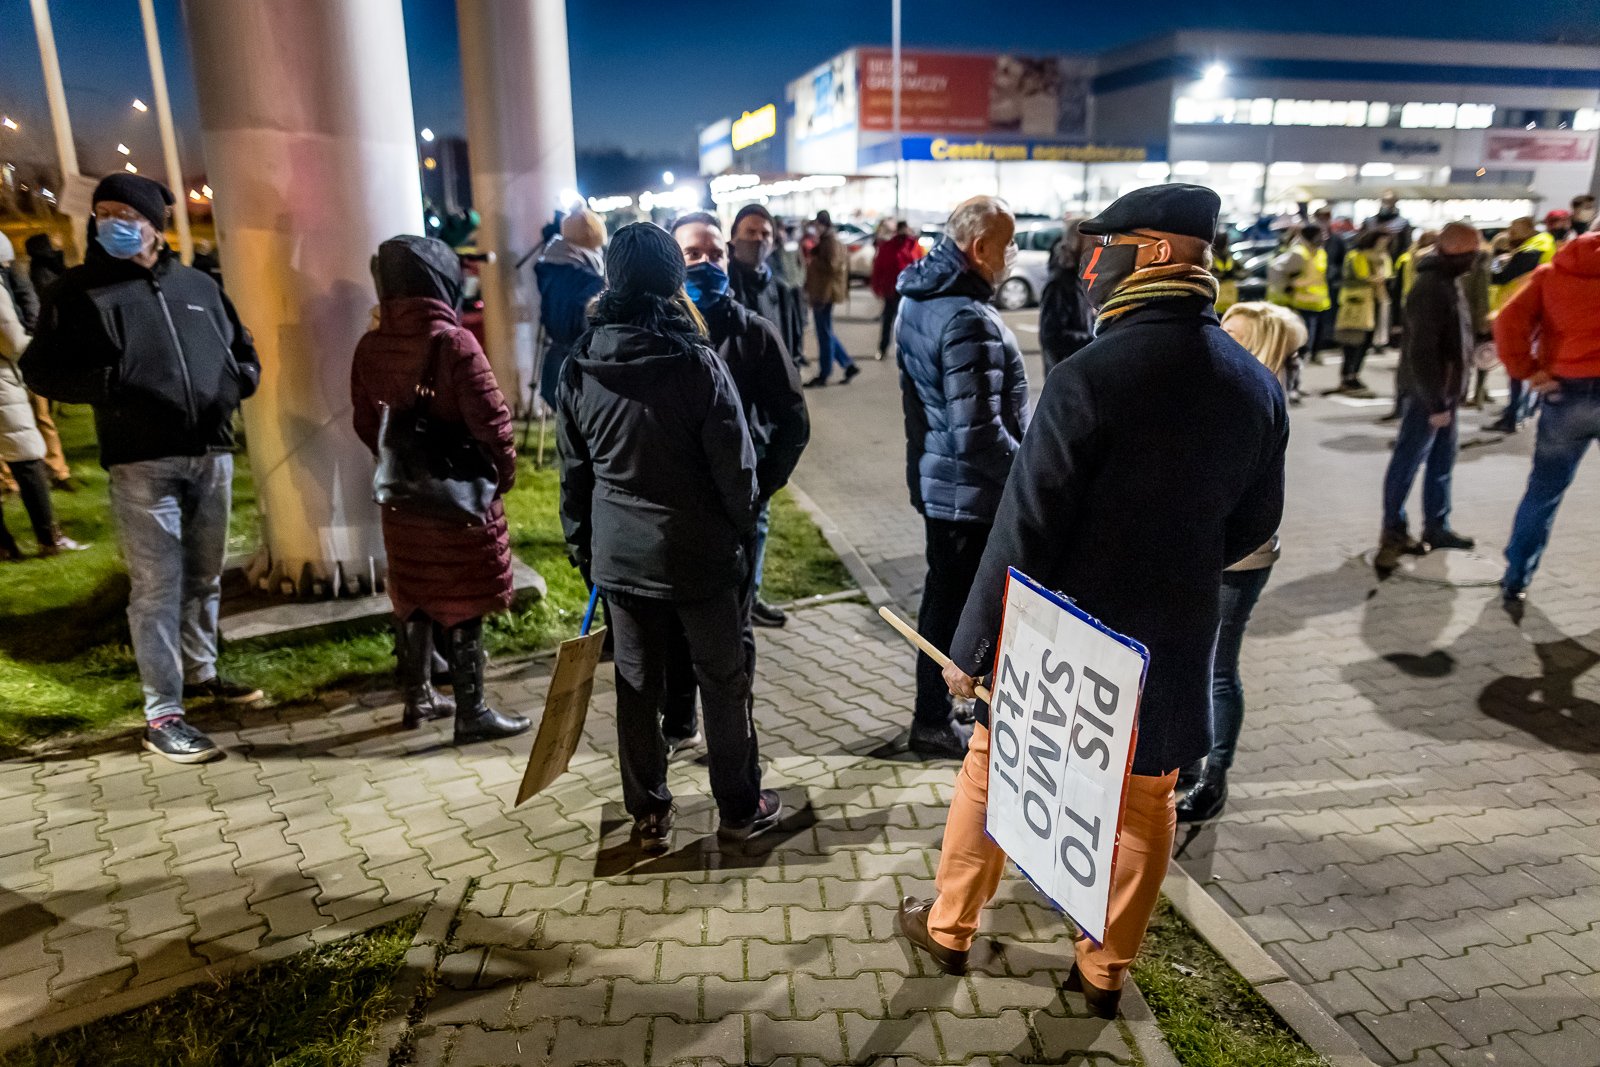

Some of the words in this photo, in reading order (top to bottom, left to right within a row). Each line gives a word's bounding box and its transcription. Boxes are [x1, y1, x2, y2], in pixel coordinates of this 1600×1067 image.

[930, 138, 1028, 160] Centrum
[994, 653, 1030, 794] ZŁO!
[1023, 648, 1075, 841] SAMO
[1072, 665, 1120, 772] PIS
[1059, 802, 1101, 888] TO
